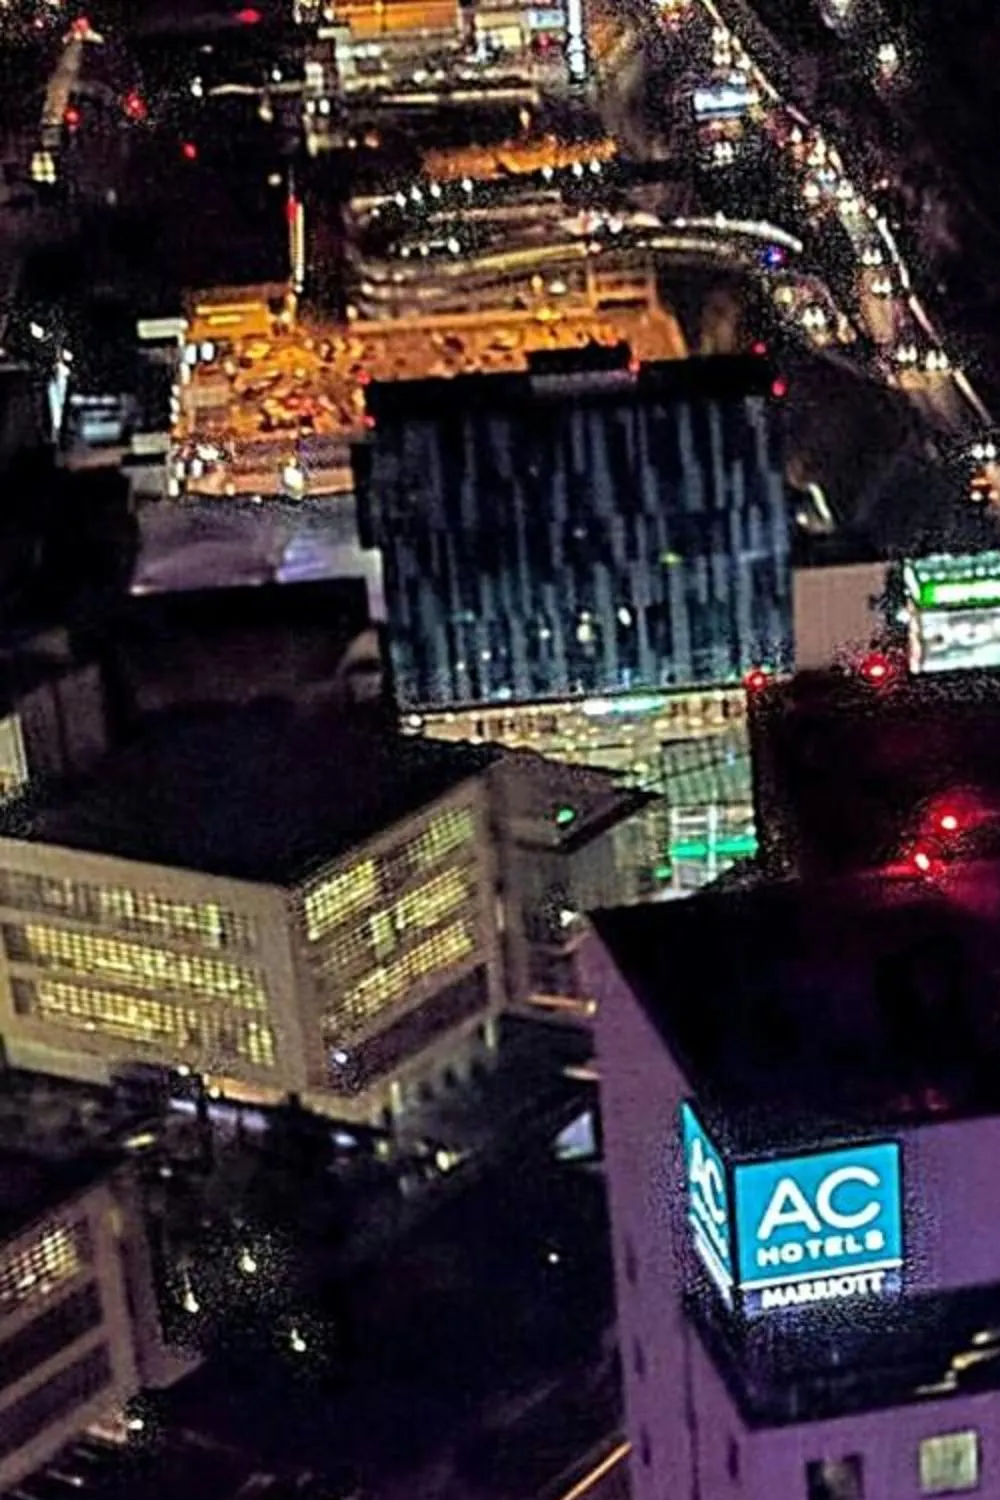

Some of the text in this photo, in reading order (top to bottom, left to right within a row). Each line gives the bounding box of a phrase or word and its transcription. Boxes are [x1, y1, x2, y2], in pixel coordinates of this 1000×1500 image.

[757, 1166, 880, 1240] AC
[757, 1230, 885, 1266] HOTELS
[762, 1272, 885, 1308] MARRIOTT
